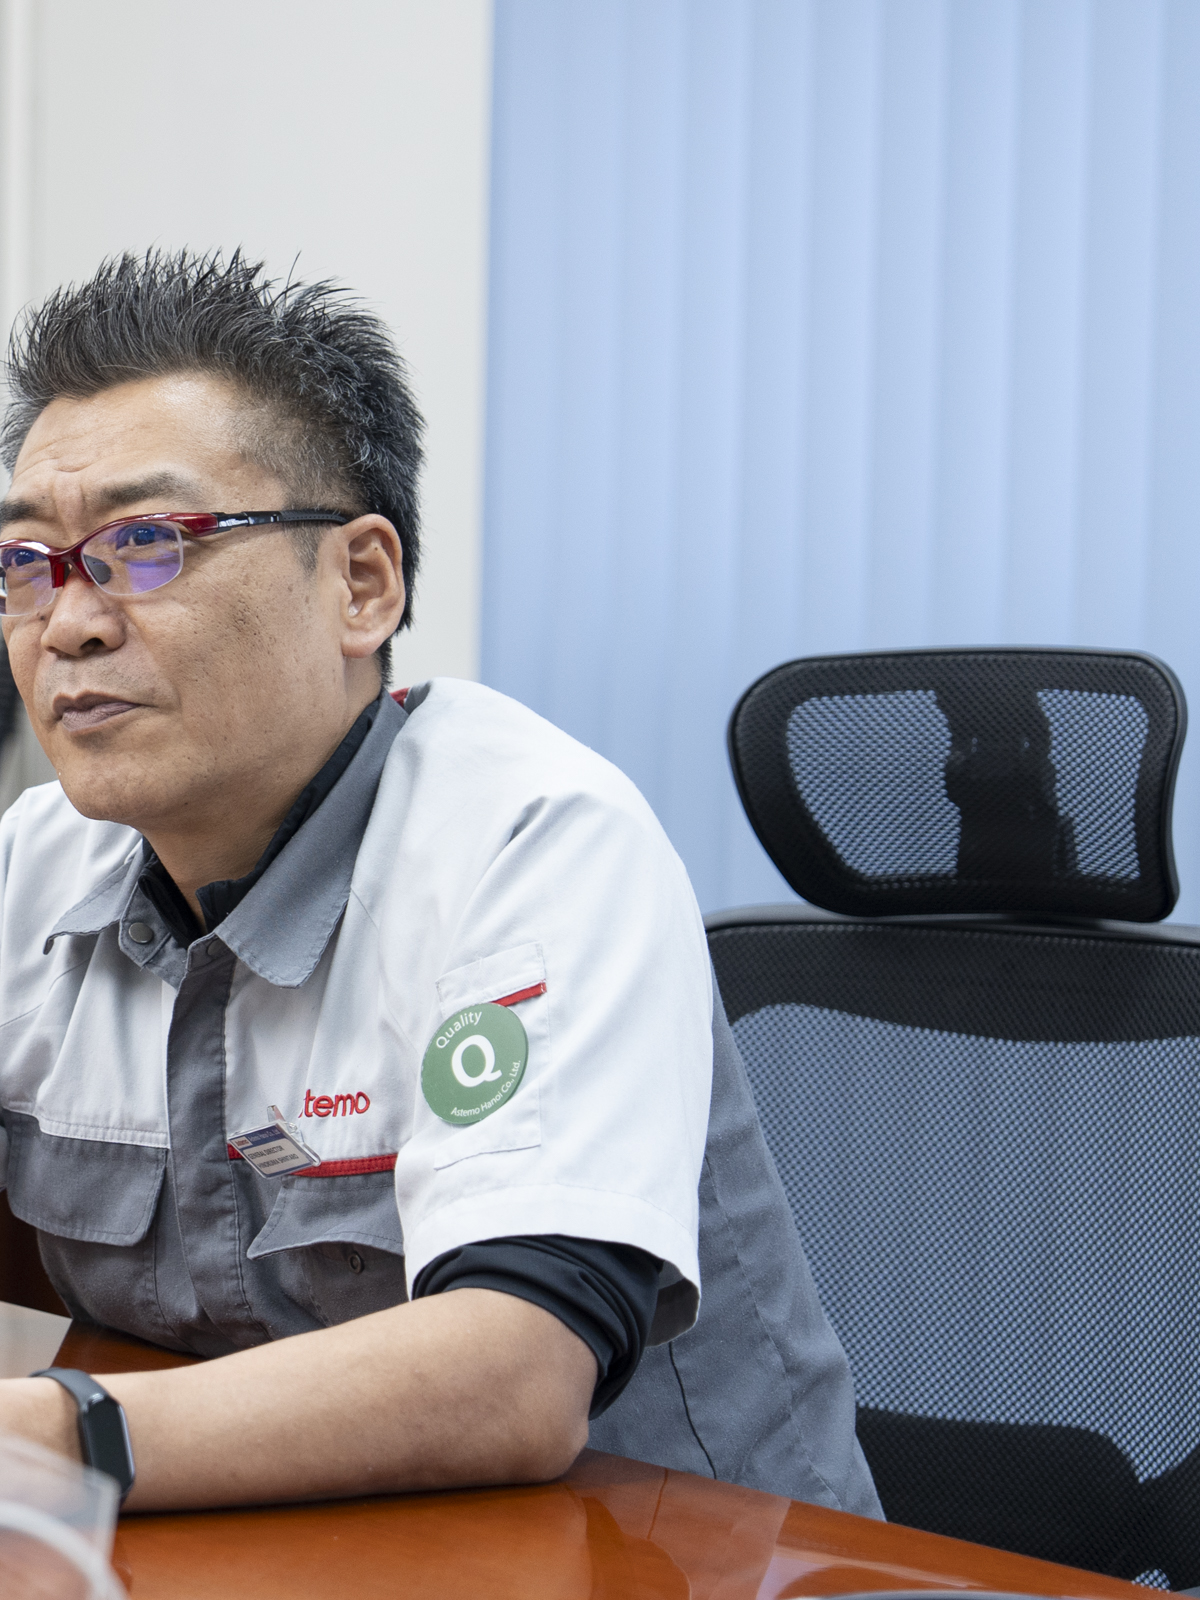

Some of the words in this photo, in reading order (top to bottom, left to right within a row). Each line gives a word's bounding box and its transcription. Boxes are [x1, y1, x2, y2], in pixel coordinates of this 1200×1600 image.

[435, 1011, 482, 1049] Quality
[451, 1034, 502, 1088] Q
[298, 1089, 370, 1118] temo
[450, 1106, 480, 1117] Astemo
[480, 1091, 503, 1112] Hanoi
[509, 1060, 521, 1077] Ltd.
